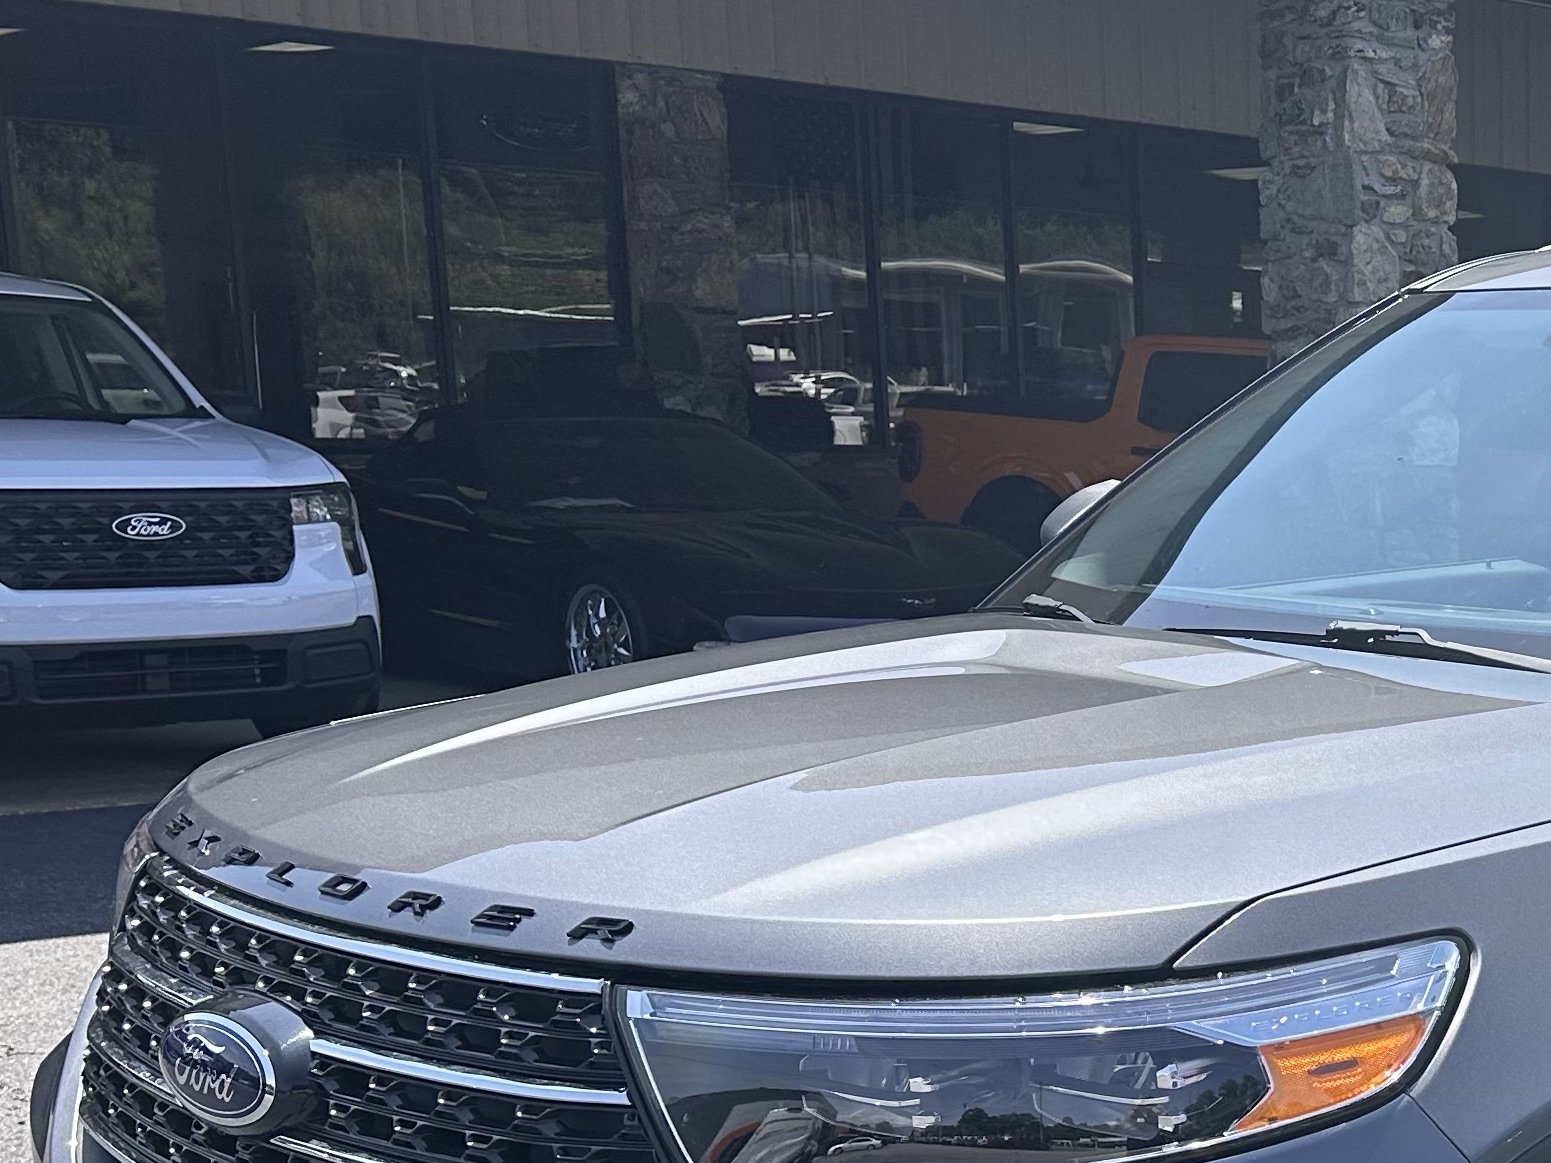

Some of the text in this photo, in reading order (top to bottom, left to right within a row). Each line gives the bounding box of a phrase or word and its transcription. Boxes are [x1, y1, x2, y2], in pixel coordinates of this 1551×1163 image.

[126, 516, 172, 536] Ford
[164, 812, 635, 946] EXPLORER
[174, 1033, 239, 1103] Ford
